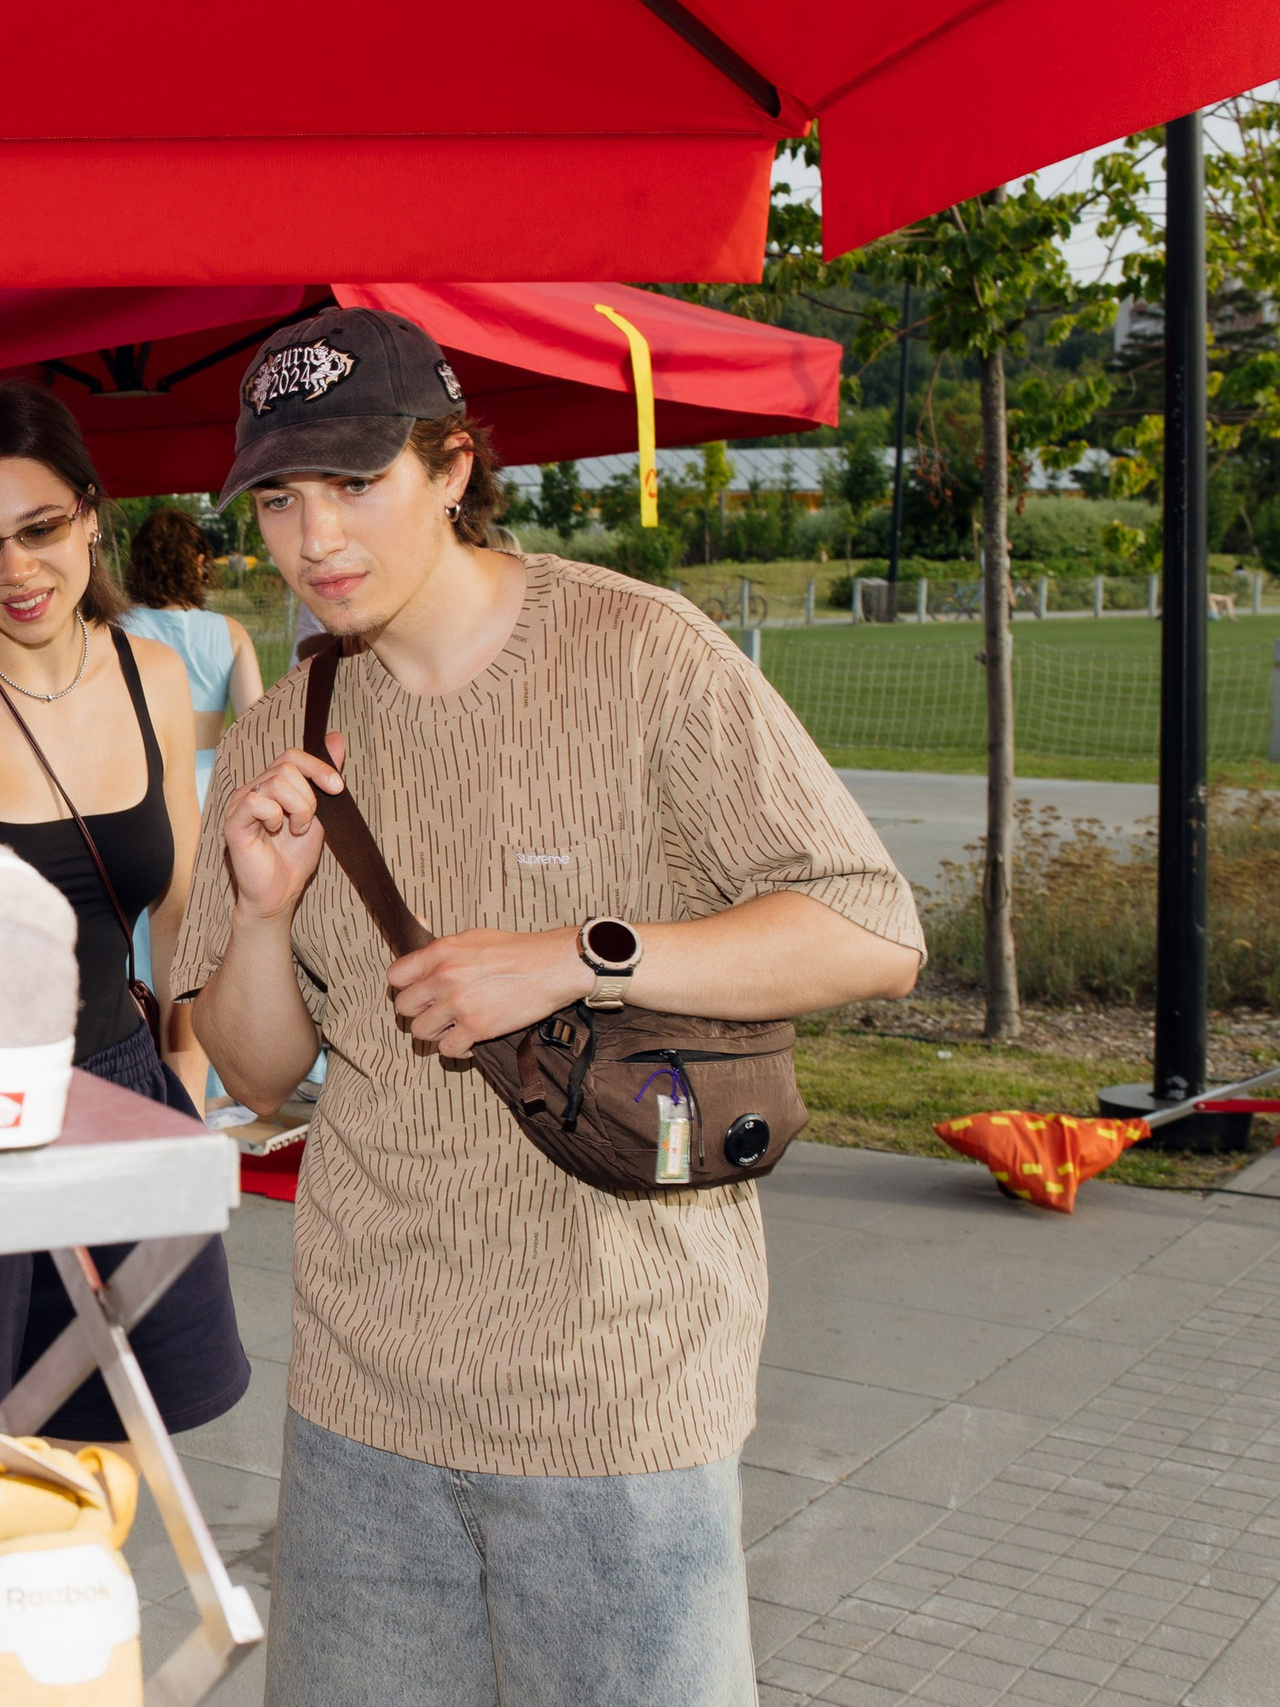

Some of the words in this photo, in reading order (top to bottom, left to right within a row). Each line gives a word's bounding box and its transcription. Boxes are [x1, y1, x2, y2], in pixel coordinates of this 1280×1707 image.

[269, 363, 312, 400] 2024
[506, 1371, 514, 1396] SUPREME
[5, 1580, 111, 1612] Reebok
